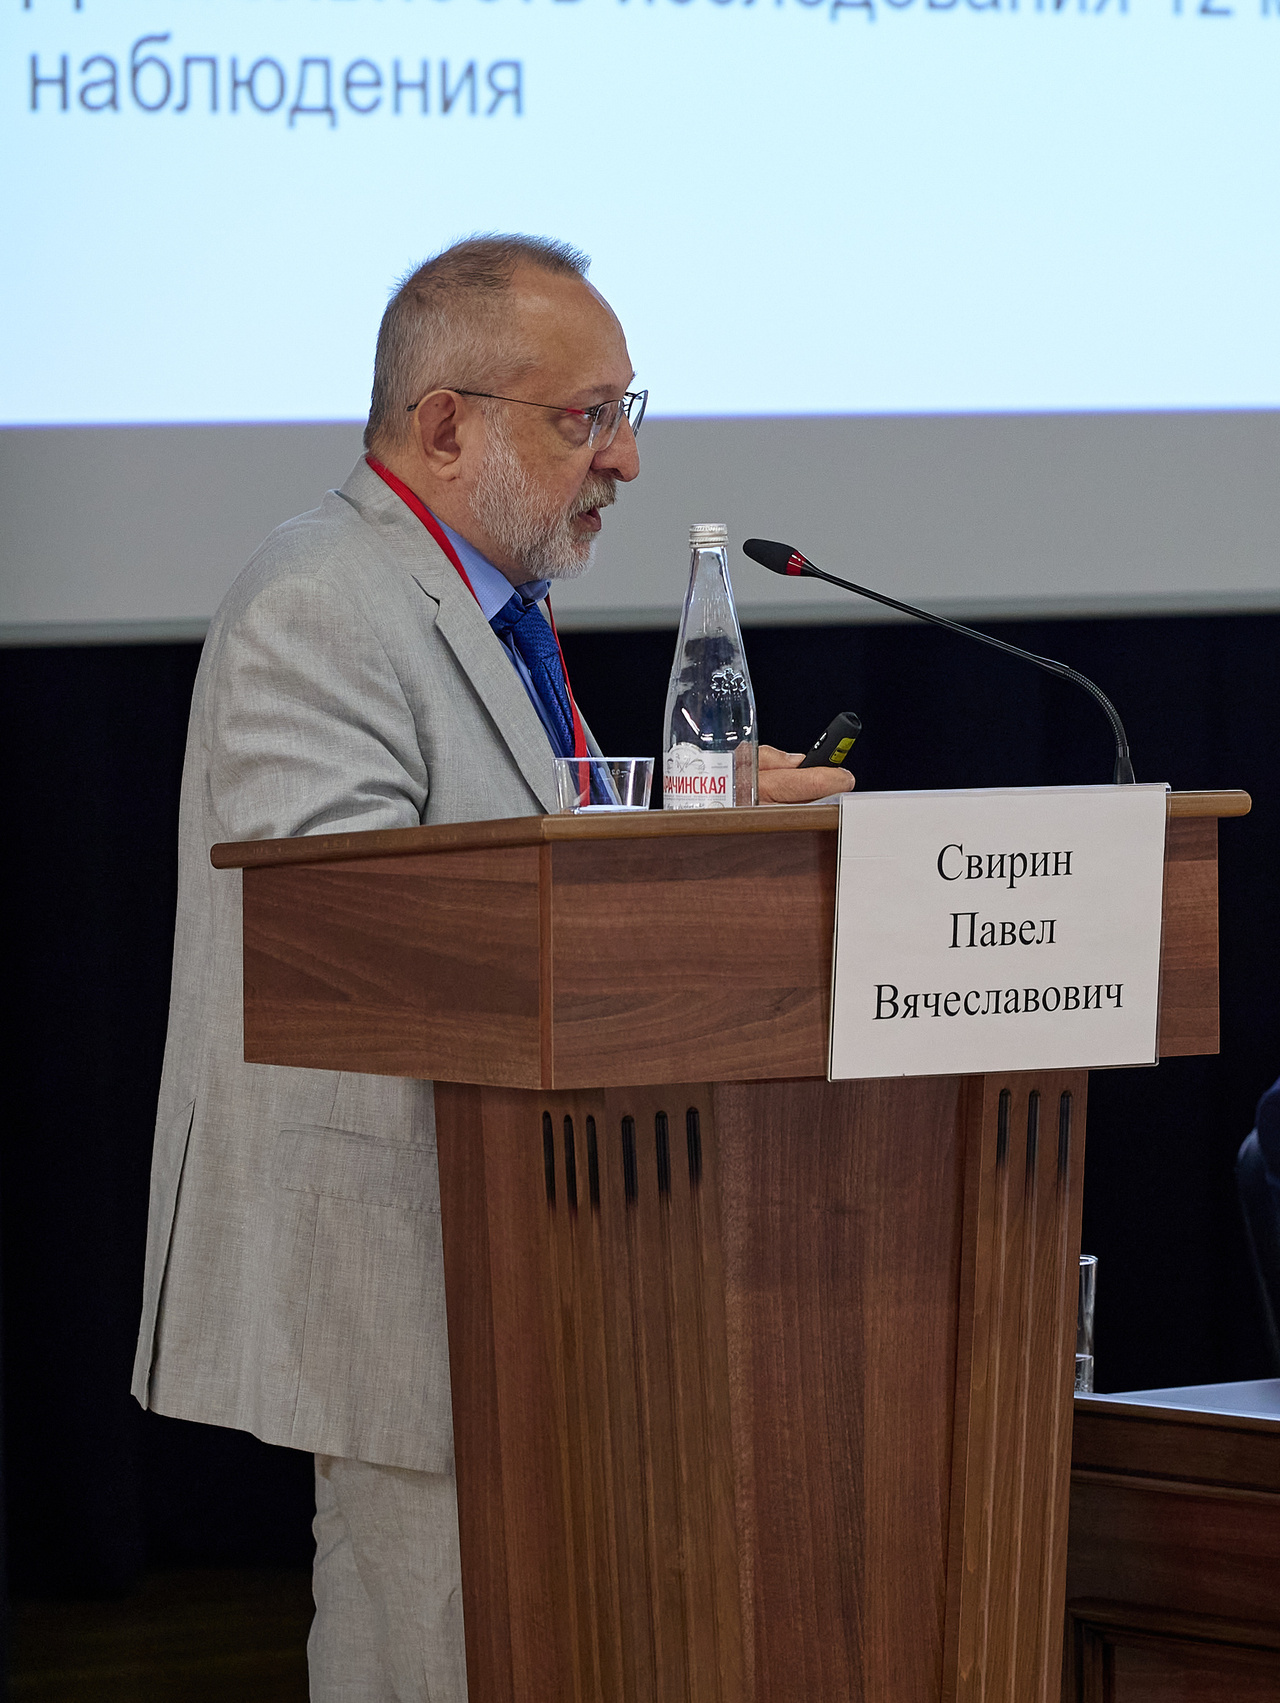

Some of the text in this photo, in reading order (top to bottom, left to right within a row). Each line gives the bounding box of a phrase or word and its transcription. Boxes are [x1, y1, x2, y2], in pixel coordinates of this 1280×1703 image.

[28, 31, 525, 131] наблюдения
[938, 844, 1073, 889] Свирин
[949, 912, 1056, 948] Павел
[873, 984, 1123, 1020] Вячеславович
